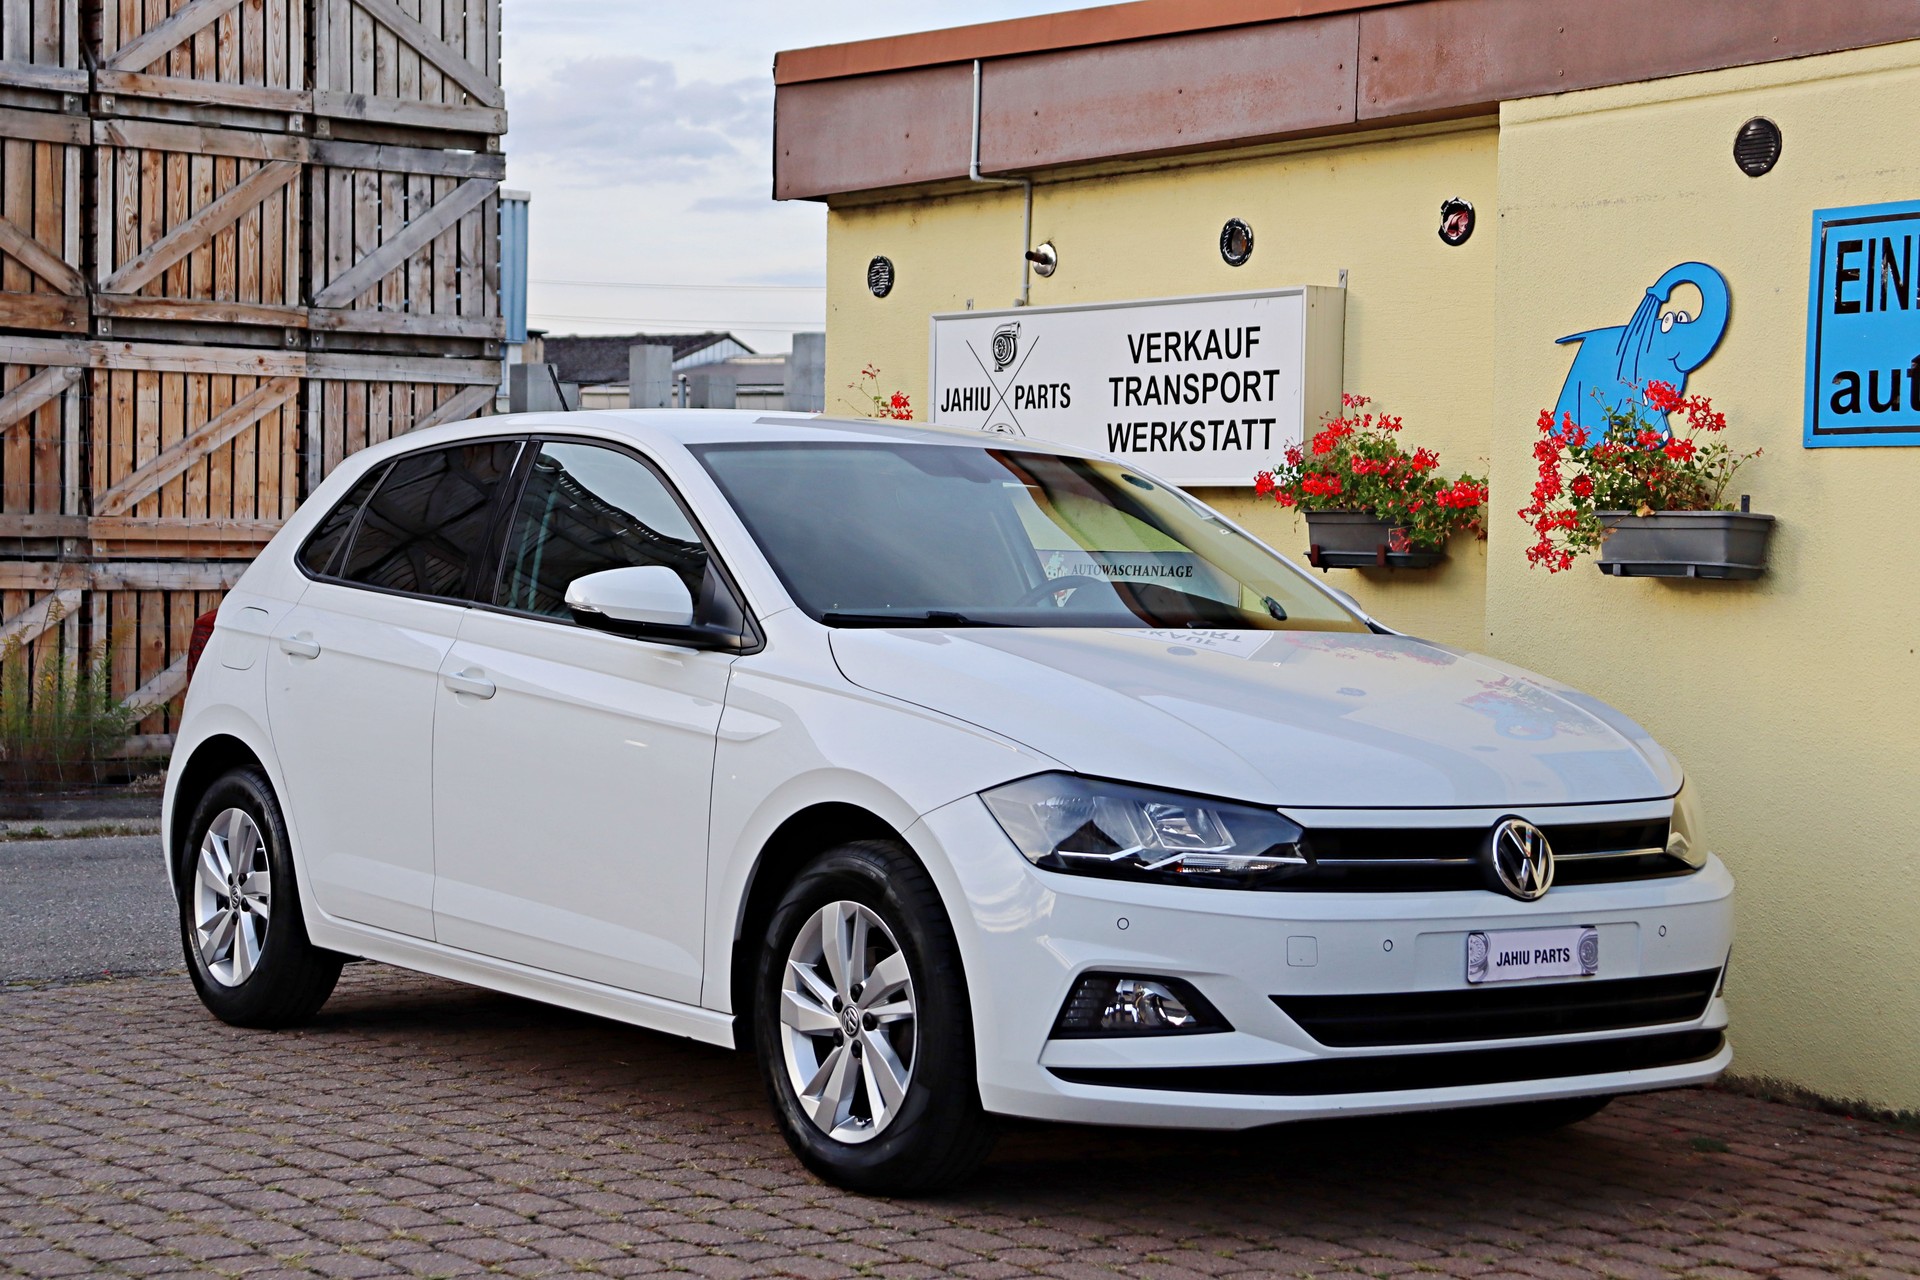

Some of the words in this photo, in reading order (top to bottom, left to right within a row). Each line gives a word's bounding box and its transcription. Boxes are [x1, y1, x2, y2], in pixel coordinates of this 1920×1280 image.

[1834, 235, 1920, 314] EIN
[1128, 326, 1261, 364] VERKAUF
[941, 385, 991, 413] JAHIU
[1014, 382, 1071, 411] PARTS
[1109, 369, 1281, 407] TRANSPORT
[1107, 418, 1276, 453] WERKSTATT
[1071, 564, 1193, 578] AUTOWASCHANLAGE
[1494, 819, 1554, 899] VW
[1496, 949, 1530, 967] JAHIU
[1534, 947, 1570, 964] PARTS
